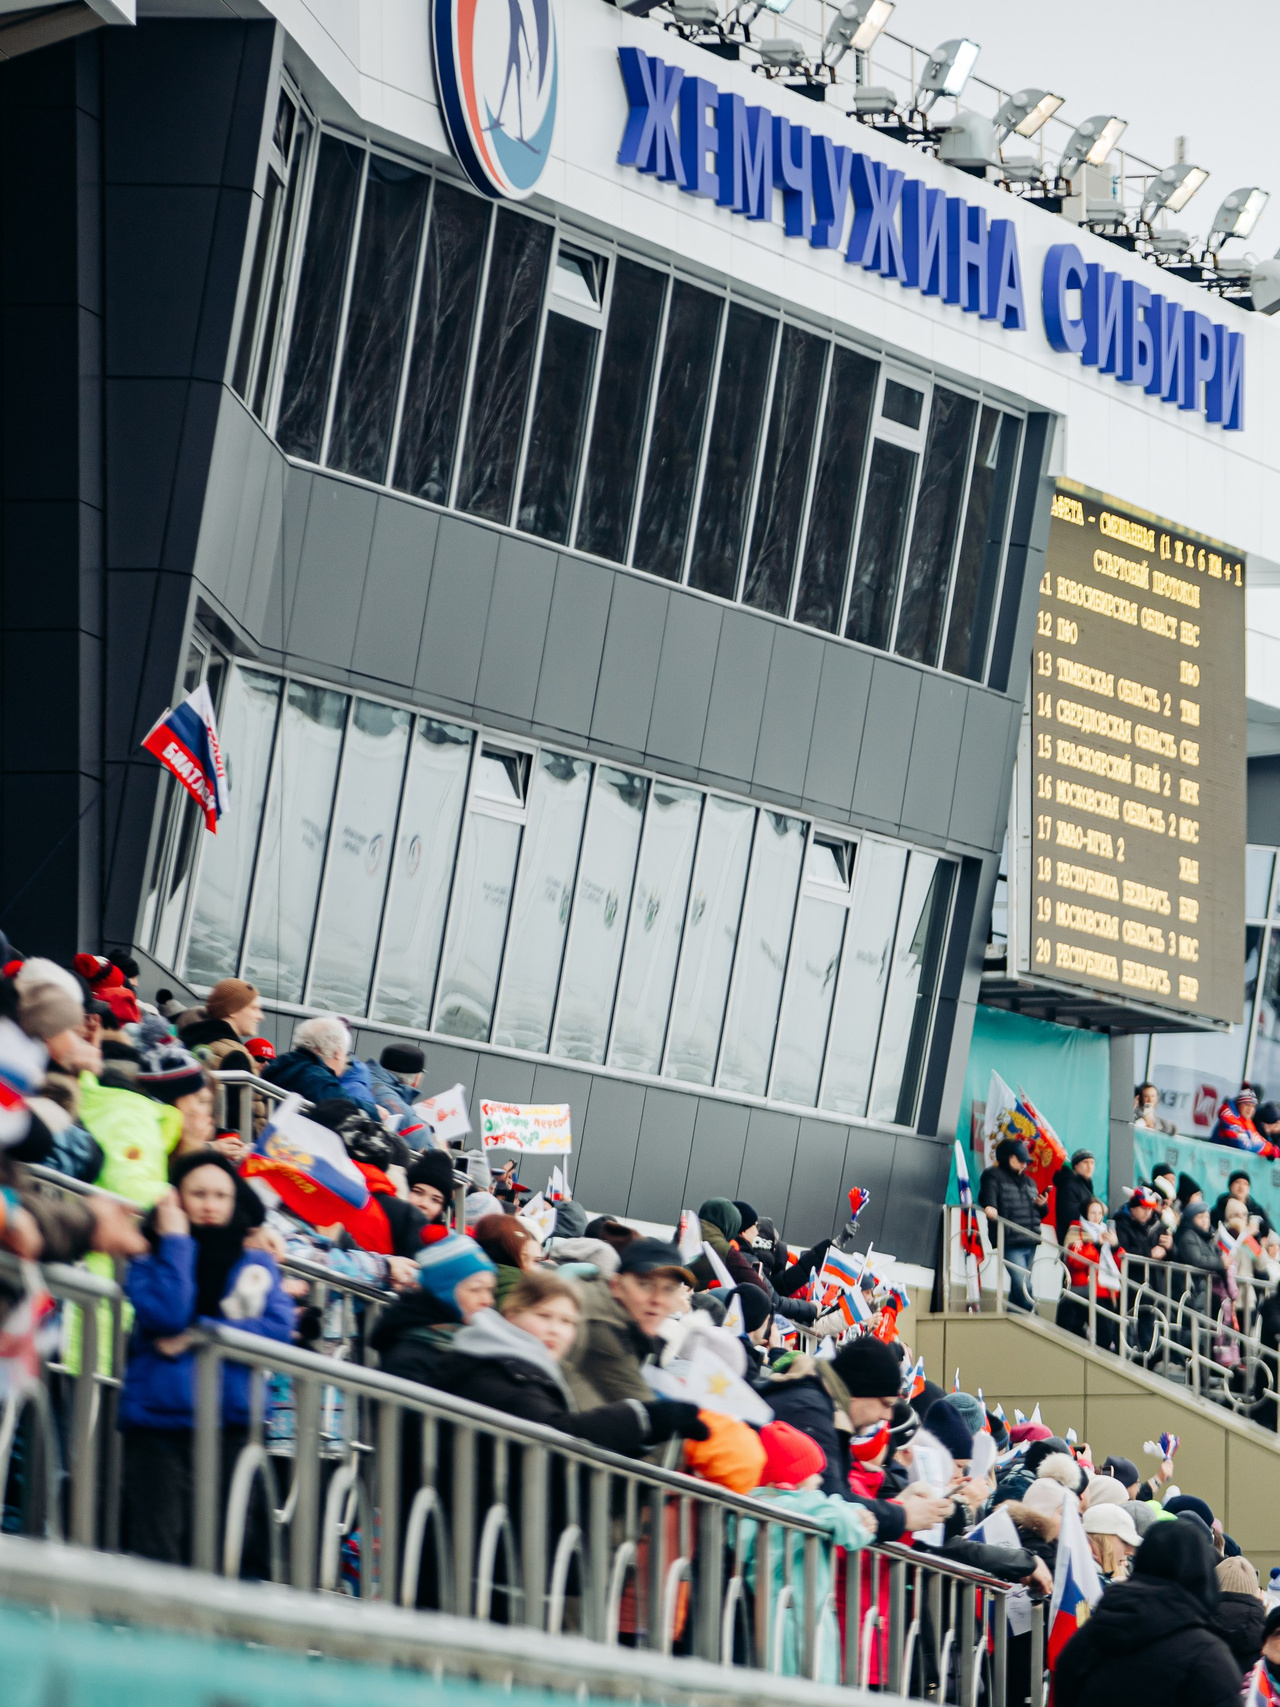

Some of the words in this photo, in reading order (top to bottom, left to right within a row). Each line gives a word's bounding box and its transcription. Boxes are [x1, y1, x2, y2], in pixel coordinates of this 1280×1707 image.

[617, 46, 1026, 331] ЖЕМЧУЖИНА
[1043, 243, 1246, 431] СИБИРИ
[1094, 549, 1150, 590] СТАРТОВЫЙ
[1153, 570, 1201, 609] ПРОТОКОЛ
[1100, 512, 1156, 553] СМЕШАННАЯ
[1198, 549, 1206, 572] 6
[1224, 563, 1232, 581] +
[1234, 564, 1242, 587] 1
[1038, 610, 1053, 637] 12
[1057, 576, 1139, 626] НОВОСИБИРСКАЯ
[1038, 651, 1053, 677] 13
[1057, 657, 1115, 698] ТЮМЕНСКАЯ
[1117, 678, 1161, 713] ОБЛАСТЬ
[1163, 692, 1172, 717] 2
[1038, 692, 1052, 719] 14
[1056, 699, 1133, 744] СВЕРДЛОВСКАЯ
[1135, 724, 1178, 759] ОБЛАСТЬ
[1038, 733, 1053, 760] 15
[1056, 739, 1133, 785] КРАСНОЯРСКИЙ
[1135, 763, 1161, 794] КРАЙ
[1163, 772, 1172, 797] 2
[1038, 773, 1053, 800] 16
[1056, 779, 1120, 821] МОСКОВСКАЯ
[1122, 800, 1166, 834] ОБЛАСТЬ
[1168, 813, 1177, 838] 2
[1038, 814, 1052, 841] 17
[1056, 820, 1114, 860] ХМАО-ЮГРА
[1117, 837, 1125, 863] 2
[1038, 856, 1052, 883] 18
[1056, 861, 1120, 902] РЕСПУБЛИКА
[1122, 880, 1172, 916] БЕЛАРУСЬ
[1037, 896, 1052, 923] 19
[1056, 901, 1120, 941] МОСКОВСКАЯ
[1122, 920, 1166, 954] ОБЛАСТЬ
[1169, 931, 1177, 957] 3
[1036, 937, 1052, 964] 20
[1056, 943, 1120, 982] РЕСПУБЛИКА
[1122, 960, 1172, 995] БЕЛАРУСЬ
